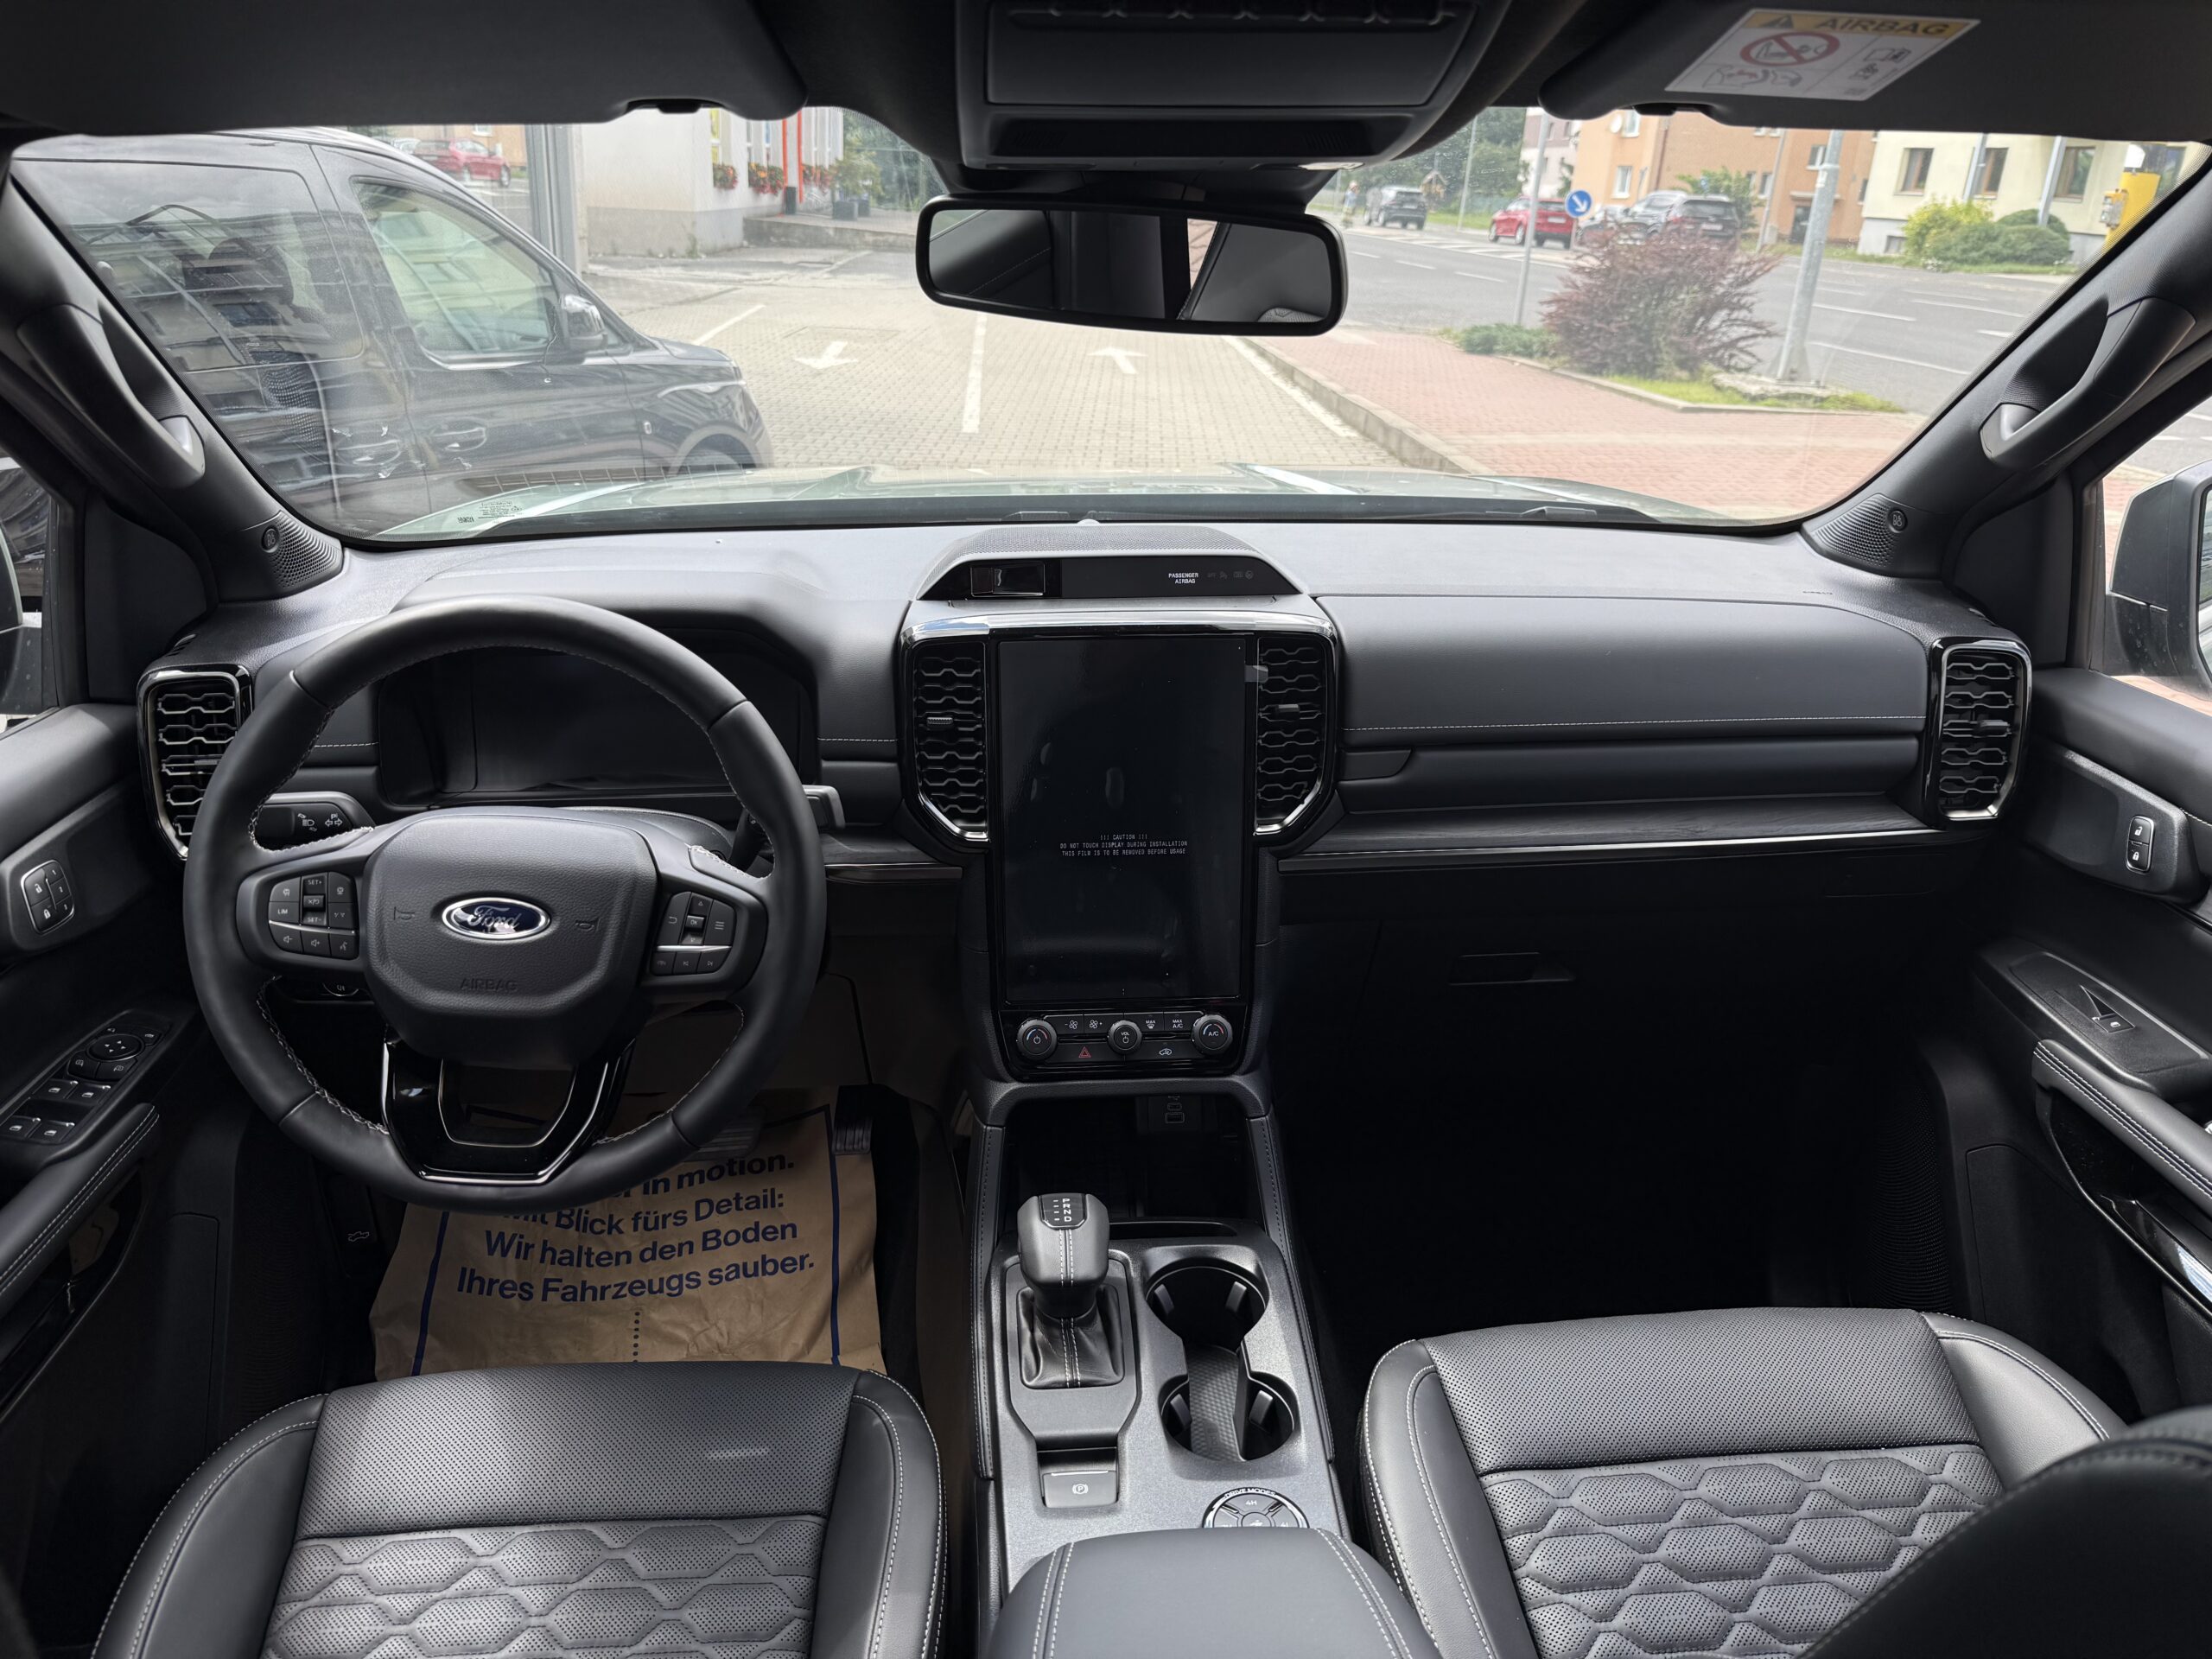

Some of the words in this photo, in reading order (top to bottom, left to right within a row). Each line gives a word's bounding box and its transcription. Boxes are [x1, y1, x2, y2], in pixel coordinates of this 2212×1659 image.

[1815, 17, 1949, 35] AIRBAG
[460, 977, 518, 993] AIRBAG
[677, 1154, 794, 1190] motion.
[556, 1208, 625, 1236] Blick
[632, 1209, 688, 1232] fürs
[695, 1187, 784, 1222] Detail:
[486, 1230, 535, 1262] Wir
[540, 1244, 632, 1268] halten
[639, 1241, 694, 1263] den
[701, 1221, 798, 1252] Boden
[457, 1268, 534, 1302] Ihres
[542, 1272, 701, 1302] Fahrzeugs
[708, 1250, 815, 1287] sauber.
[1224, 1488, 1246, 1498] DRIVE
[1247, 1487, 1277, 1497] MODES
